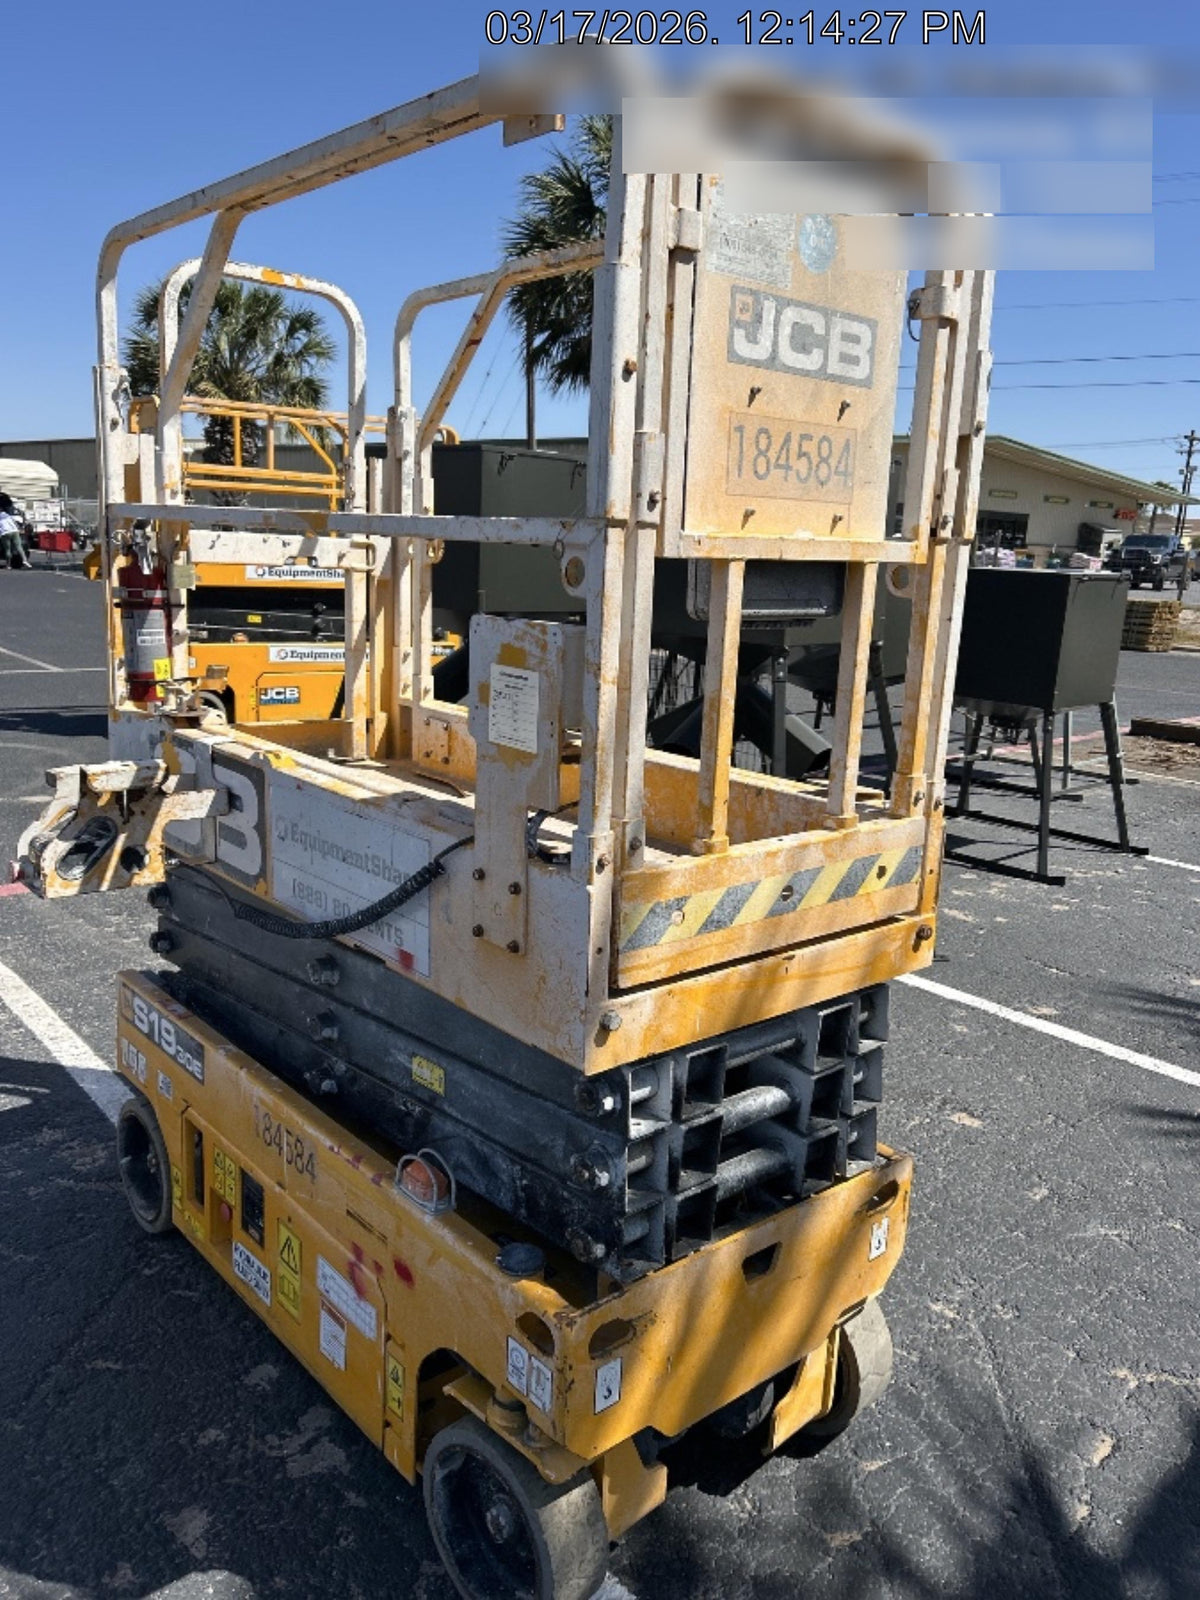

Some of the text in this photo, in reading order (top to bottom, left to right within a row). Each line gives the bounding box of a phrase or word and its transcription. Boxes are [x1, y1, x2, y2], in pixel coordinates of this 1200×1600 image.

[733, 297, 872, 380] JCB
[733, 424, 852, 486] 184584
[260, 687, 299, 700] JCB
[253, 1103, 316, 1185] 184584
